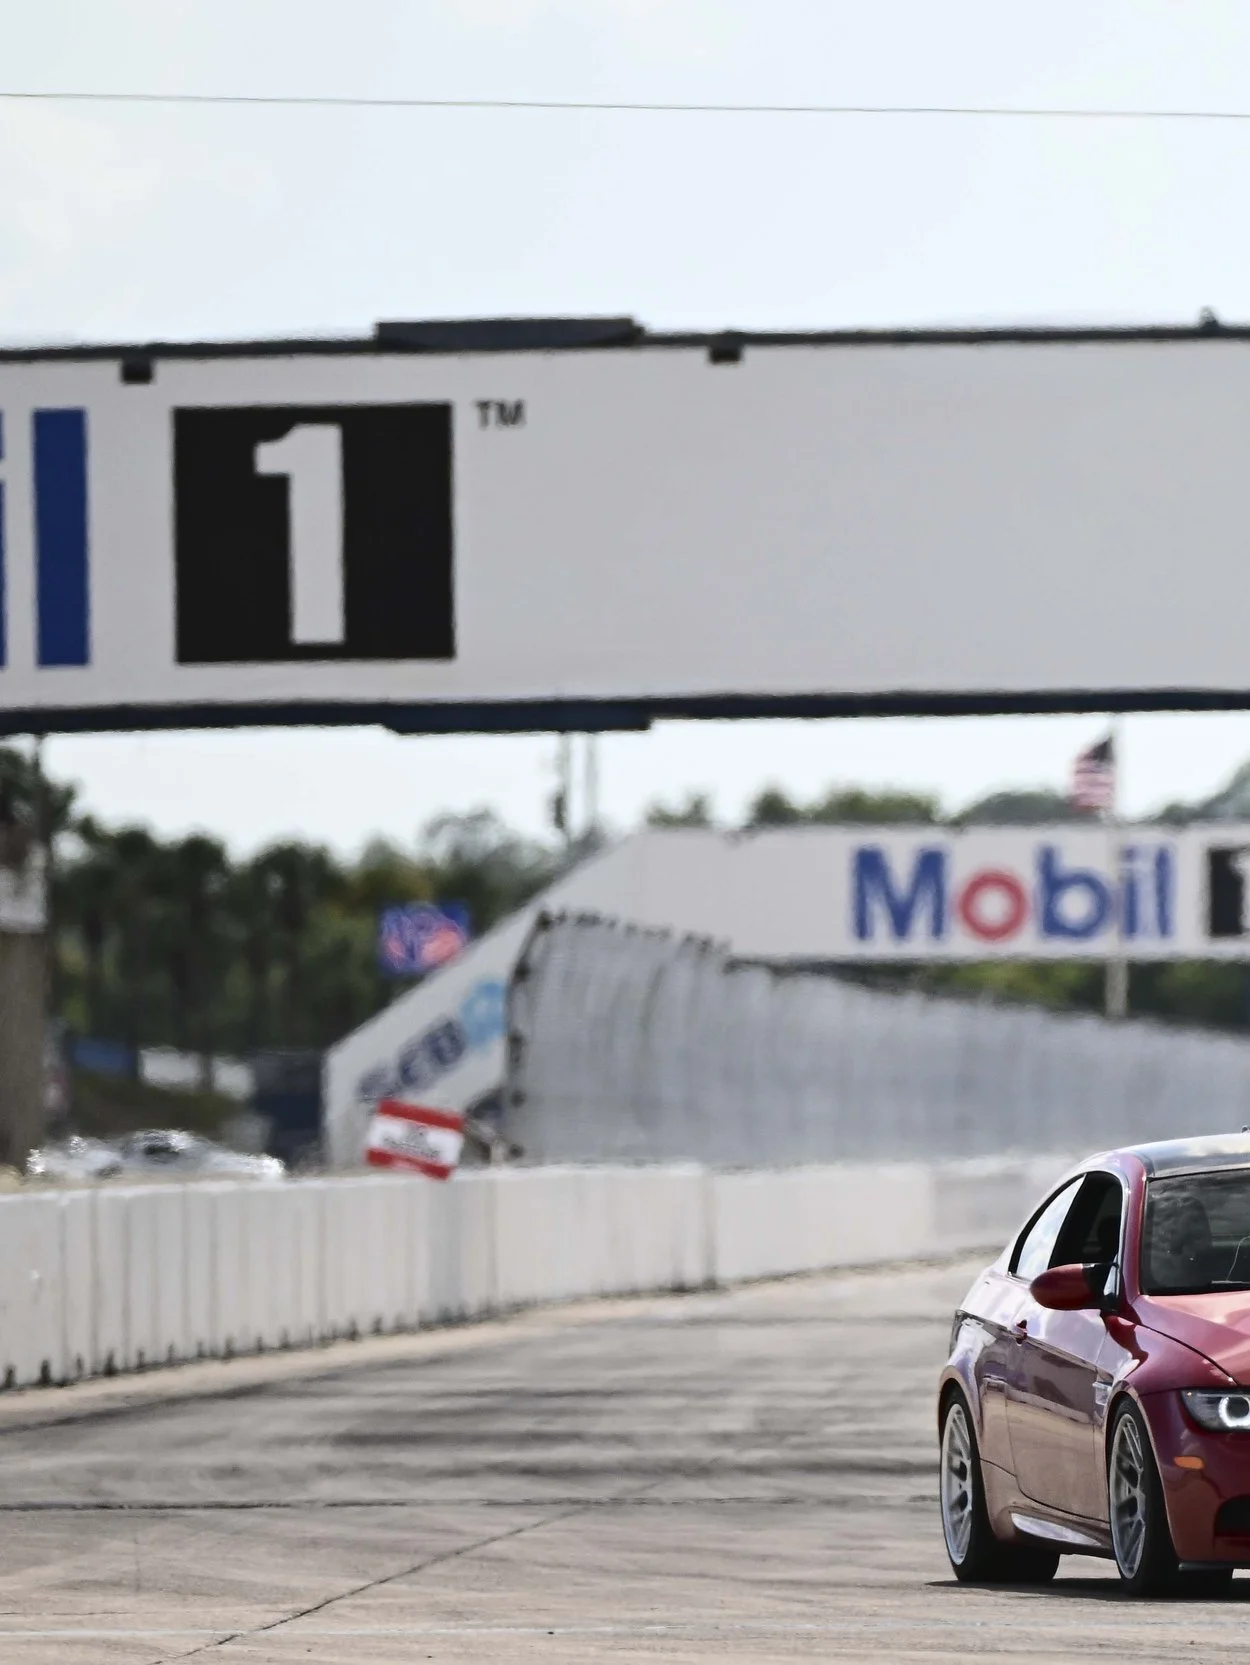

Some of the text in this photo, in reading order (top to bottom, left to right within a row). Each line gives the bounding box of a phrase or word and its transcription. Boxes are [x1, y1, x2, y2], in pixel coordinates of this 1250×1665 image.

[253, 422, 346, 645] 1
[474, 399, 526, 428] TM
[851, 842, 1174, 941] Mobil
